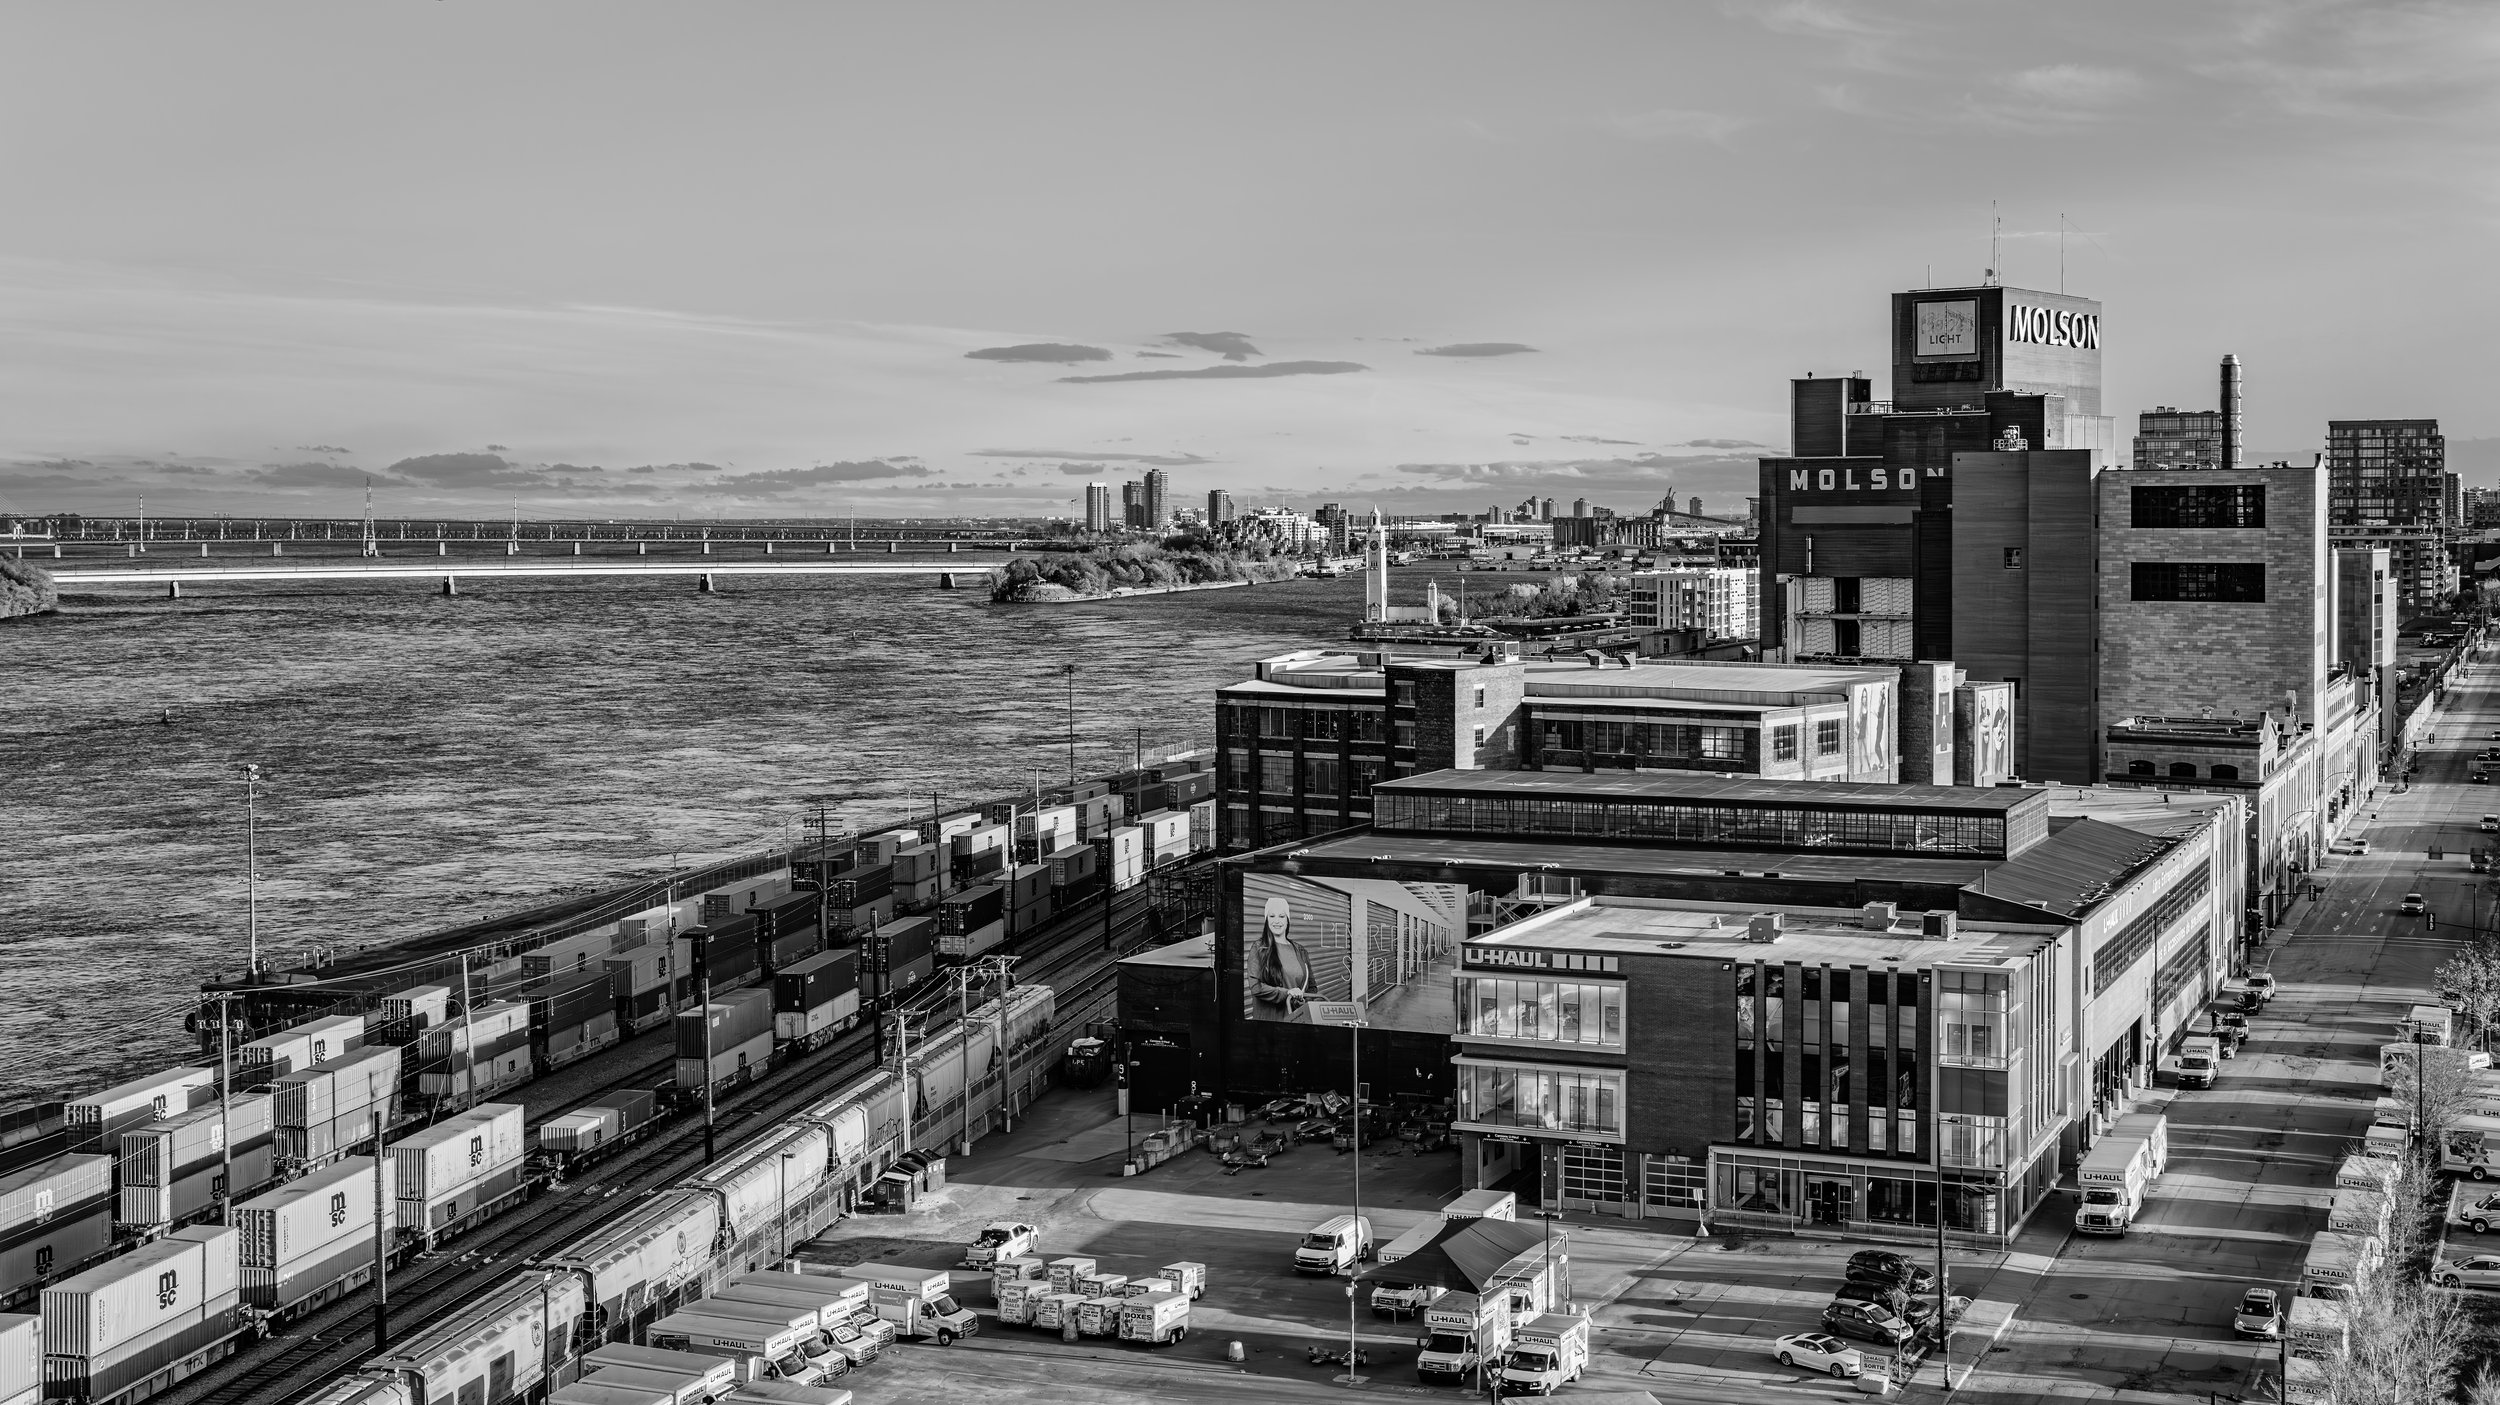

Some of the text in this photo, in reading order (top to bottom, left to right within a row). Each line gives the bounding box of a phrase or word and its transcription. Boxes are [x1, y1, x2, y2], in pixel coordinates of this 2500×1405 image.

[2010, 303, 2099, 350] MOLSON
[1465, 948, 1547, 968] U-HAUL
[1322, 1006, 1355, 1015] U-HAUL
[2083, 1173, 2122, 1181] U-HAUL
[875, 1281, 906, 1292] U-HAUL
[927, 1279, 946, 1292] U-HAUL
[826, 1304, 848, 1318] U-HAUL
[1124, 1312, 1153, 1320] BOXES
[794, 1318, 815, 1331] U-HAUL
[1431, 1315, 1467, 1325] U-HAUL
[713, 1338, 747, 1349] U-HAUL
[771, 1335, 792, 1349] U-HAUL
[1525, 1336, 1554, 1345] U-HAUL
[710, 1367, 732, 1383] U-HAUL
[682, 1386, 704, 1401] U-HAUL
